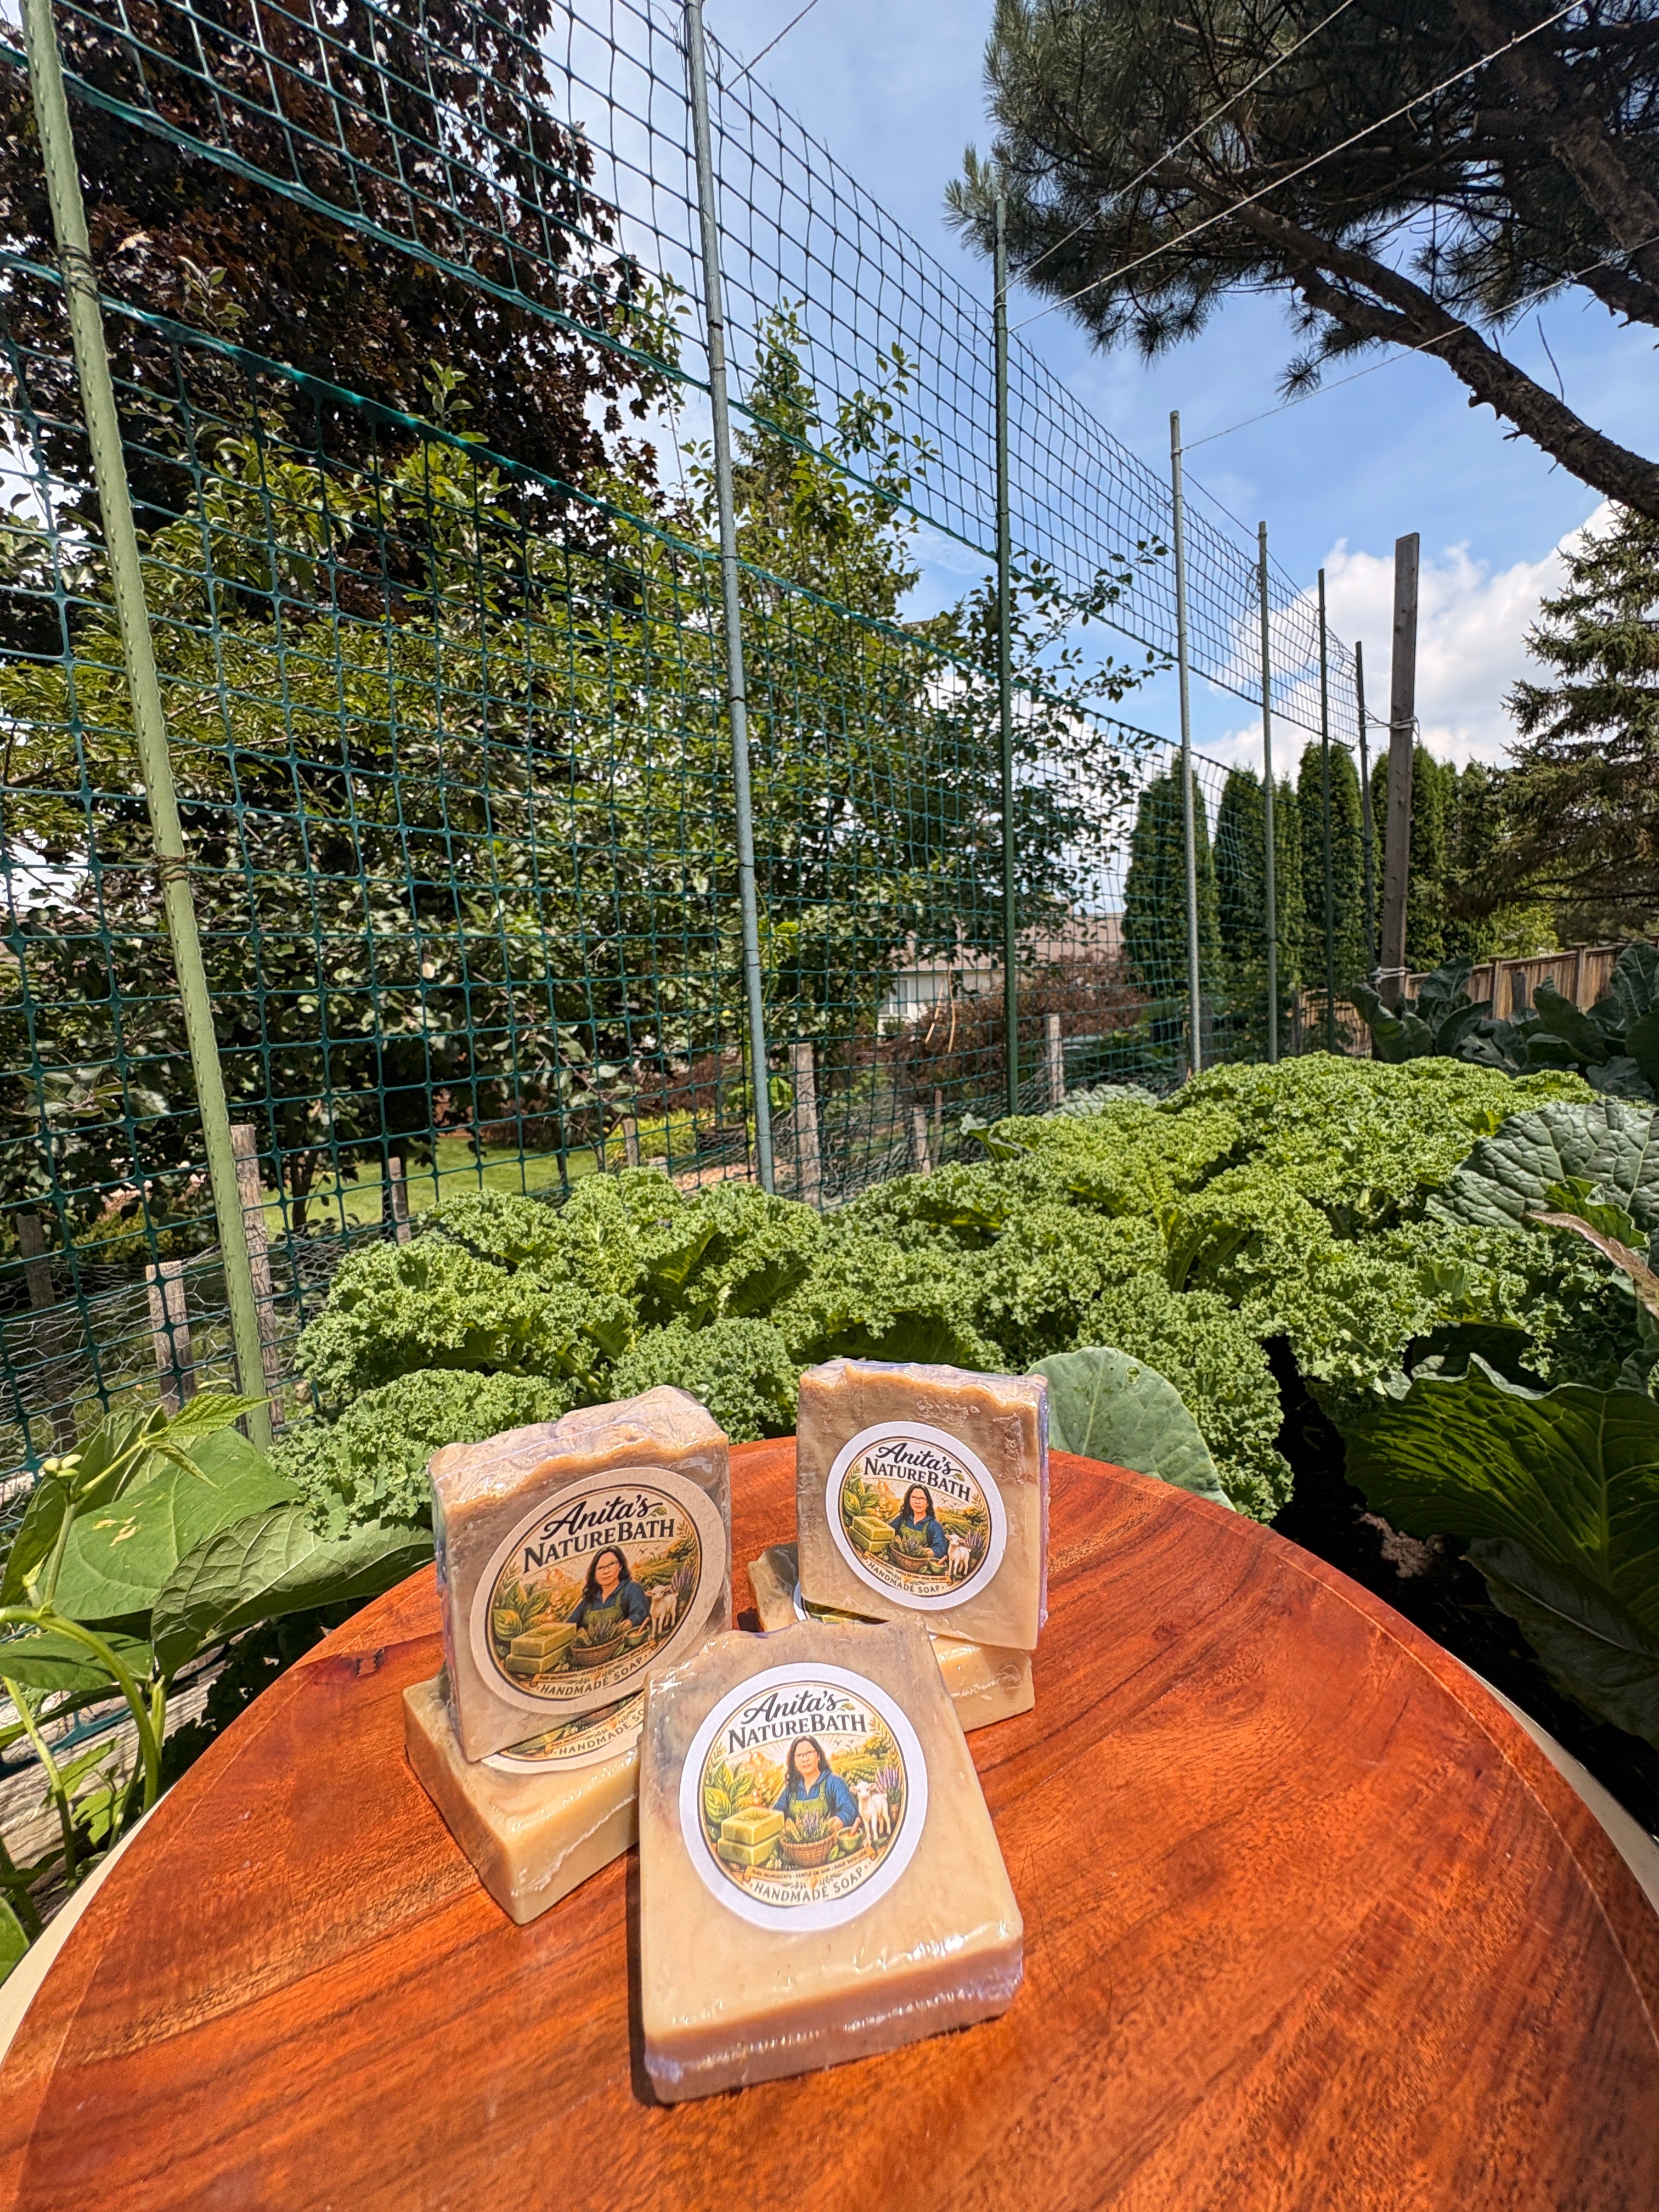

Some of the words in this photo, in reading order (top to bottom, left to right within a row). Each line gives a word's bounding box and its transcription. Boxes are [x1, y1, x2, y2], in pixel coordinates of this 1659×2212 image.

[875, 1442, 962, 1475] Anita's
[540, 1494, 663, 1540] Anita's
[868, 1562, 915, 1592] HANDMADE
[918, 1585, 940, 1594] SOAP
[539, 1677, 609, 1696] HANDMADE
[614, 1656, 642, 1680] SOAP
[741, 1690, 850, 1725] Anita's
[558, 1723, 631, 1755] HANDMADE
[632, 1709, 645, 1722] SO
[754, 1881, 830, 1902] HANDMADE
[833, 1866, 862, 1893] SOAP
